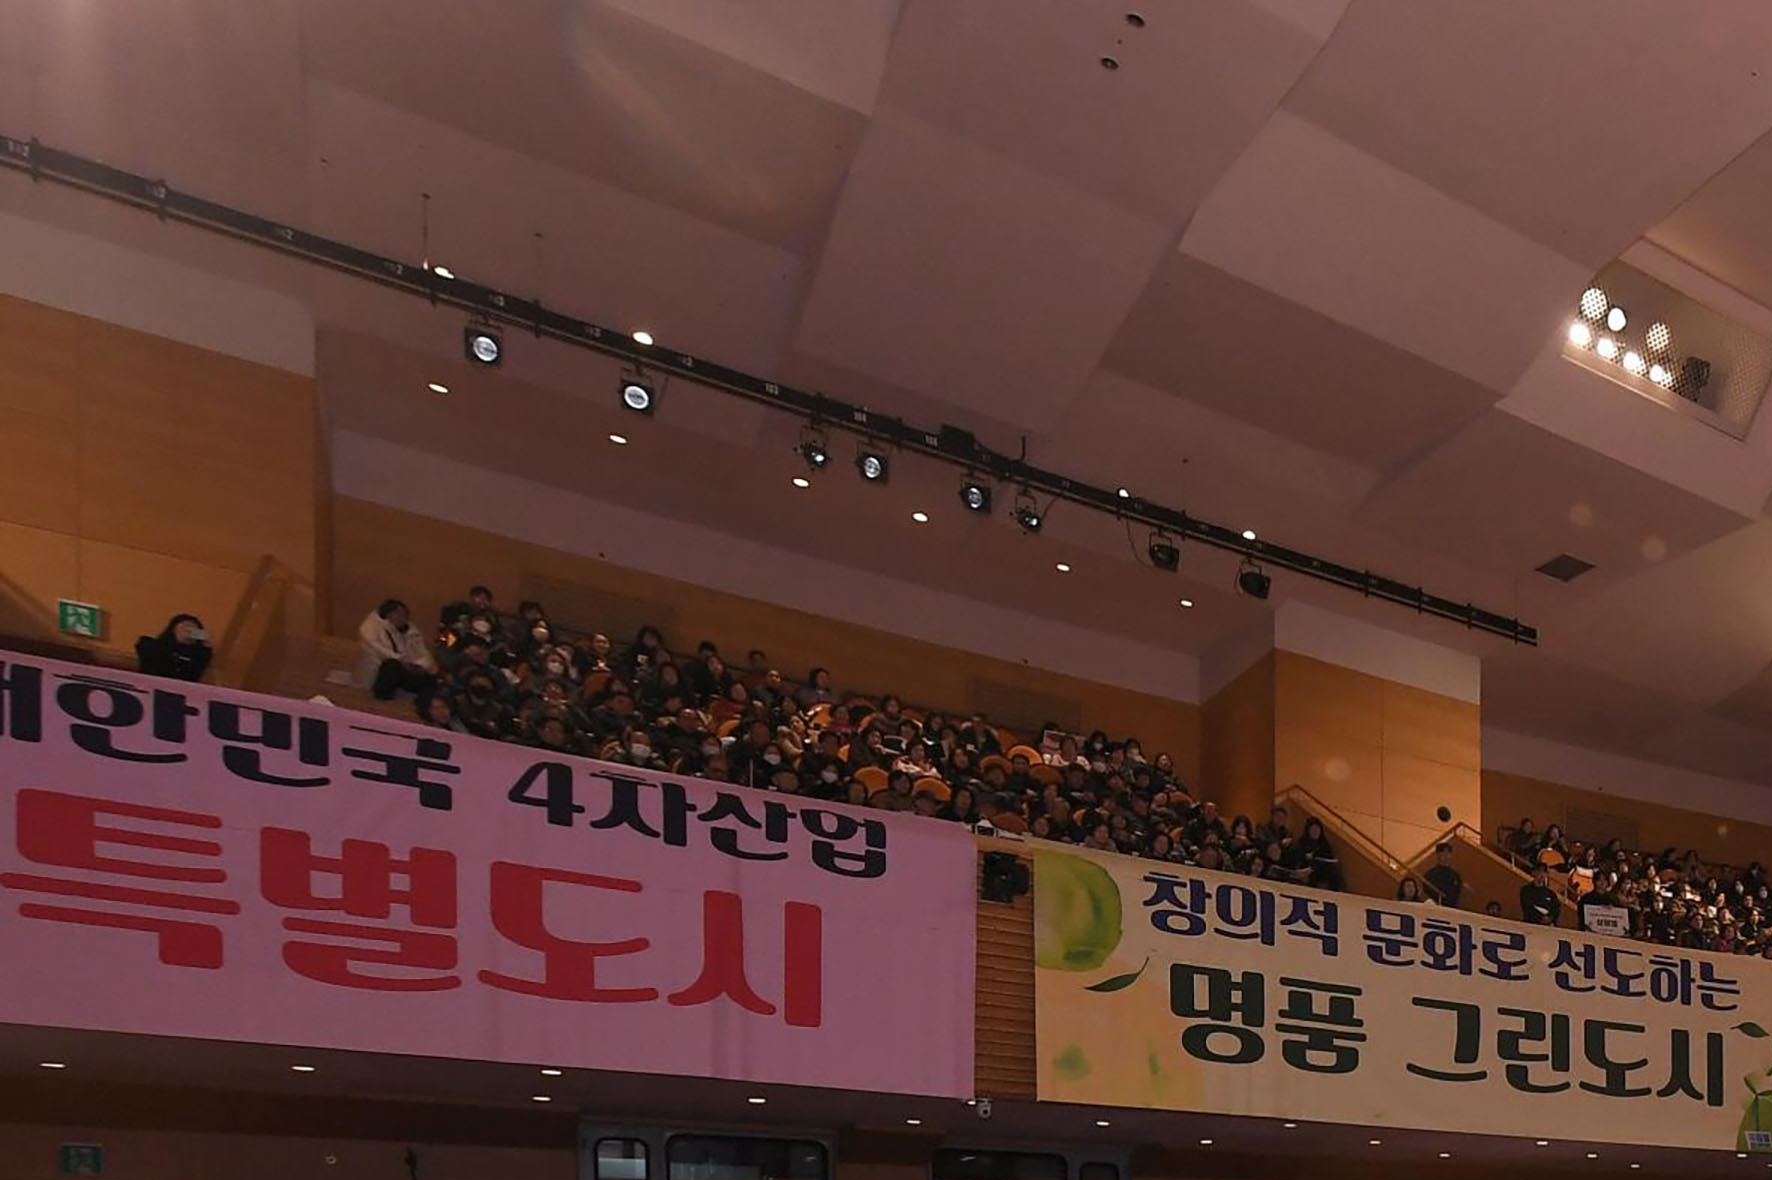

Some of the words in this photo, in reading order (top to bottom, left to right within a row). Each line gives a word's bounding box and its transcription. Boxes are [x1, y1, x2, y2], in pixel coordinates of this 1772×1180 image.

[507, 761, 888, 879] 4차산업
[0, 788, 823, 1029] 특별도시
[1142, 872, 1339, 957] 창의적
[1362, 908, 1530, 981] 문화로
[1547, 940, 1742, 1012] 선도하는
[1169, 963, 1368, 1075] 명품
[1406, 996, 1726, 1107] 그린도시
